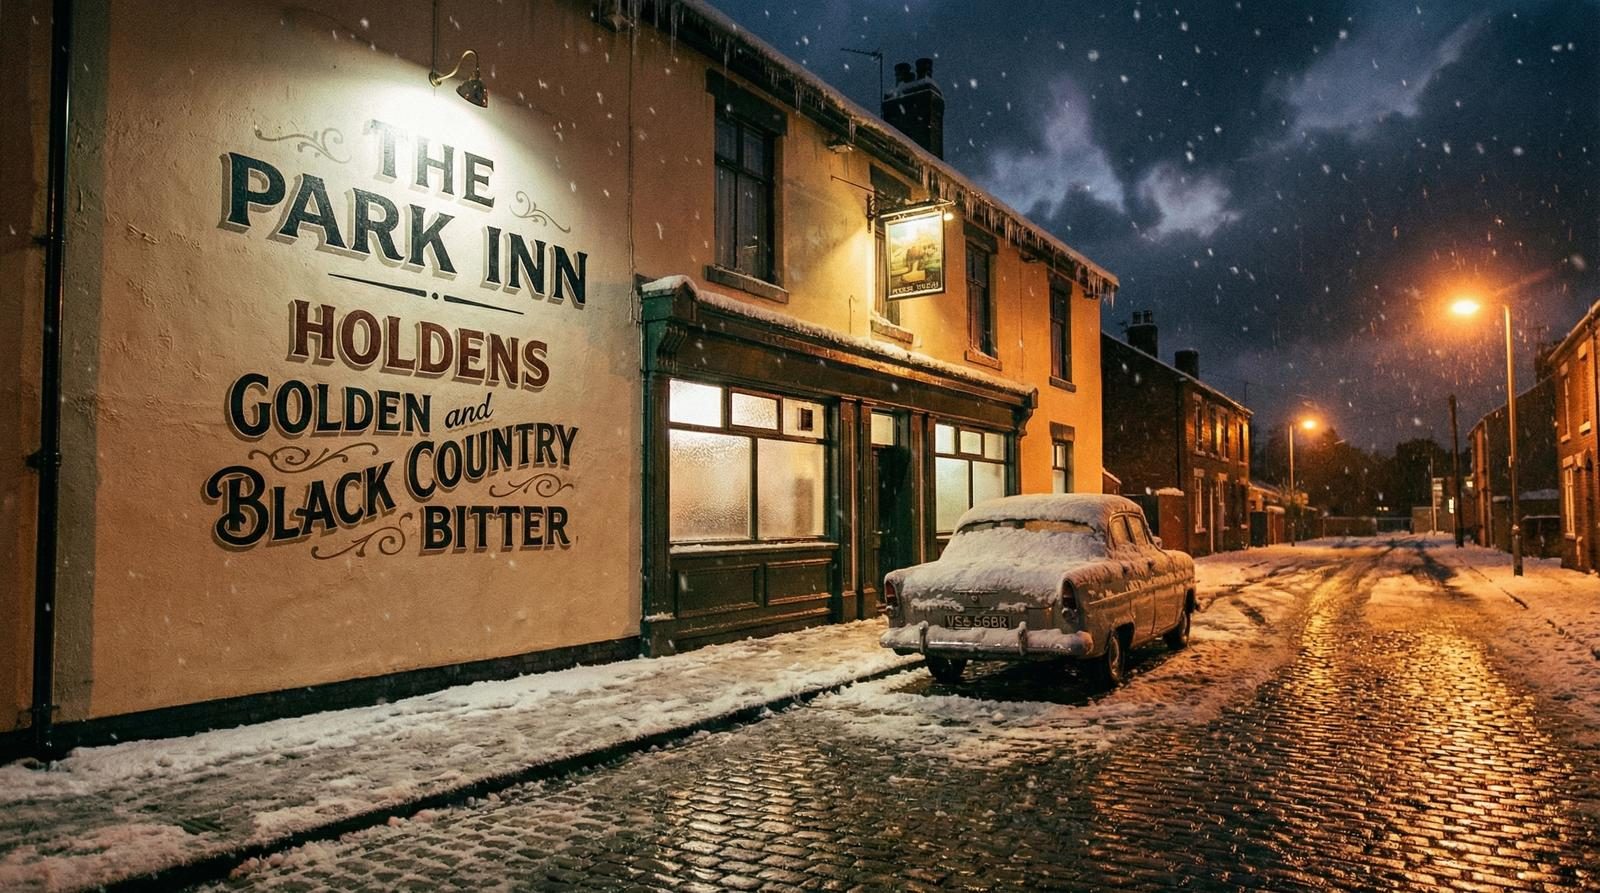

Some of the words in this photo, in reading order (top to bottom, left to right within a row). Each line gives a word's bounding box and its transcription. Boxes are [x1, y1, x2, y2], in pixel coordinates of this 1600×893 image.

[364, 119, 496, 210] THE
[219, 152, 458, 277] PARK
[484, 225, 588, 308] INN
[289, 299, 550, 390] HOLDENS
[227, 373, 432, 440] GOLDEN
[444, 392, 494, 428] and
[203, 460, 397, 550] BLACK
[407, 423, 579, 501] COUNTRY
[420, 506, 571, 555] BITTER
